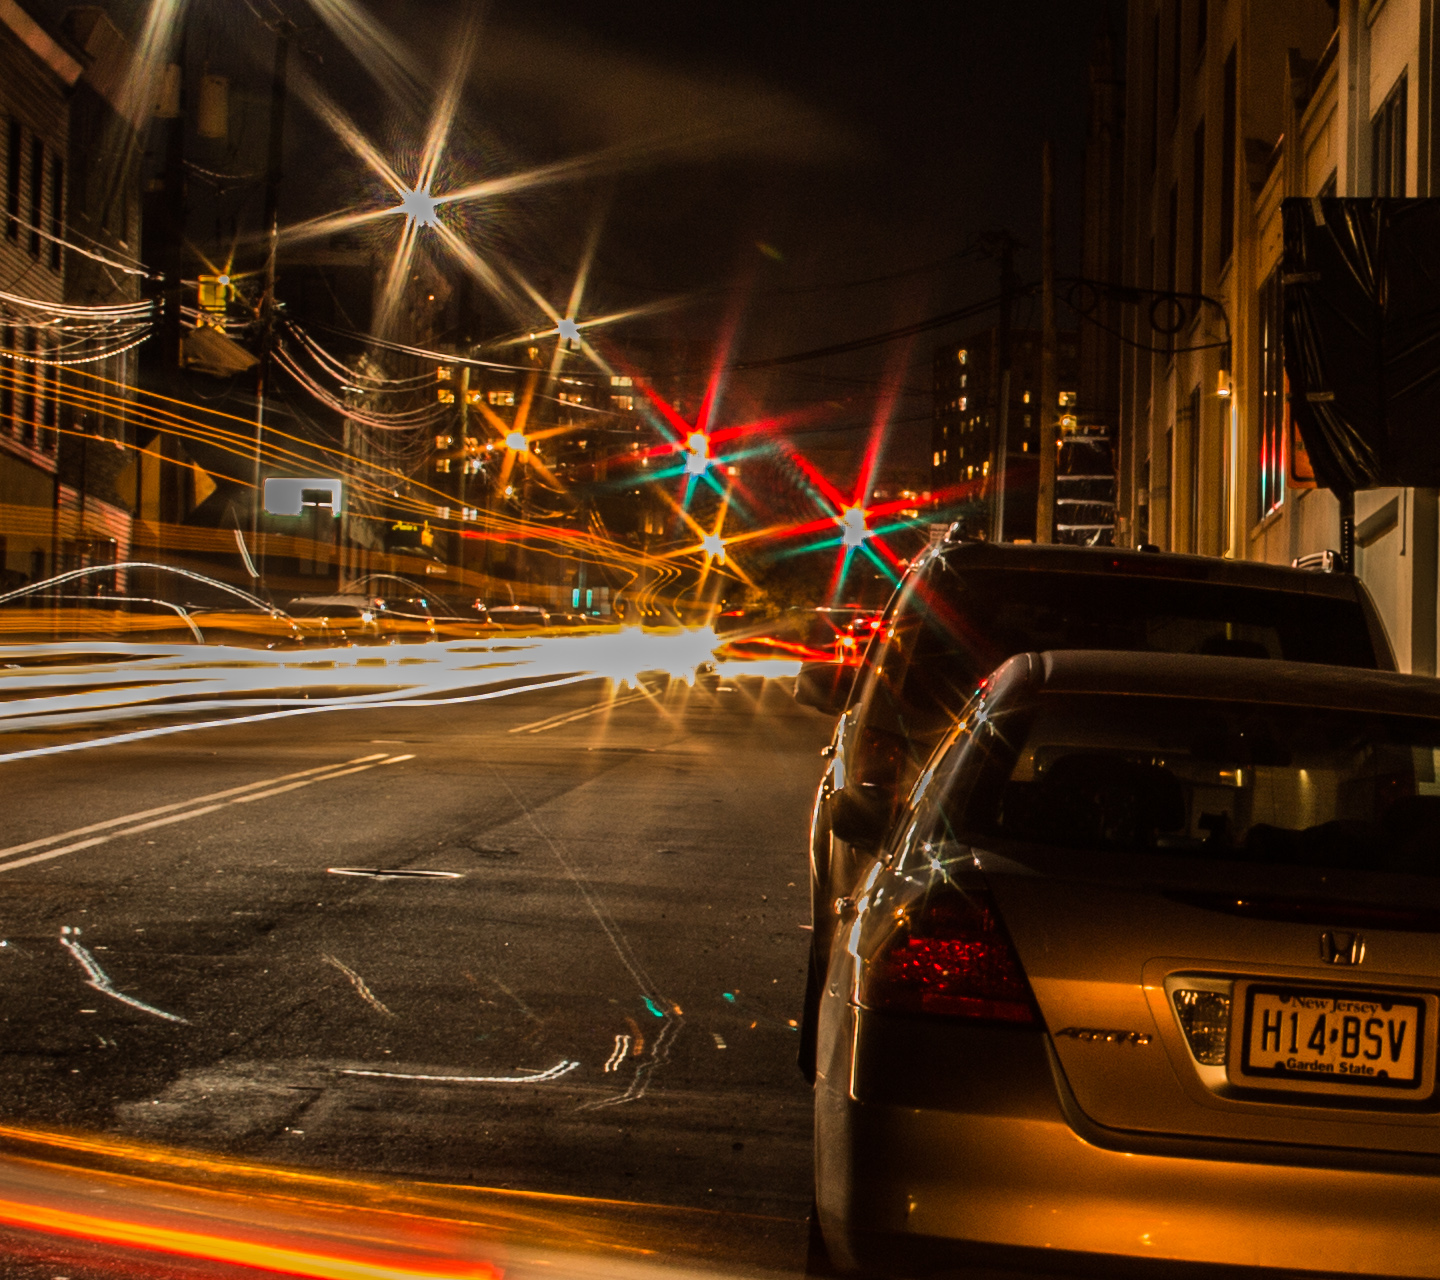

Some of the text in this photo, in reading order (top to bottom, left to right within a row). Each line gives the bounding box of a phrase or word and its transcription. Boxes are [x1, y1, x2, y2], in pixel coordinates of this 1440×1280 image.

[1291, 995, 1379, 1016] New Jersey
[1286, 1057, 1375, 1076] Garden State
